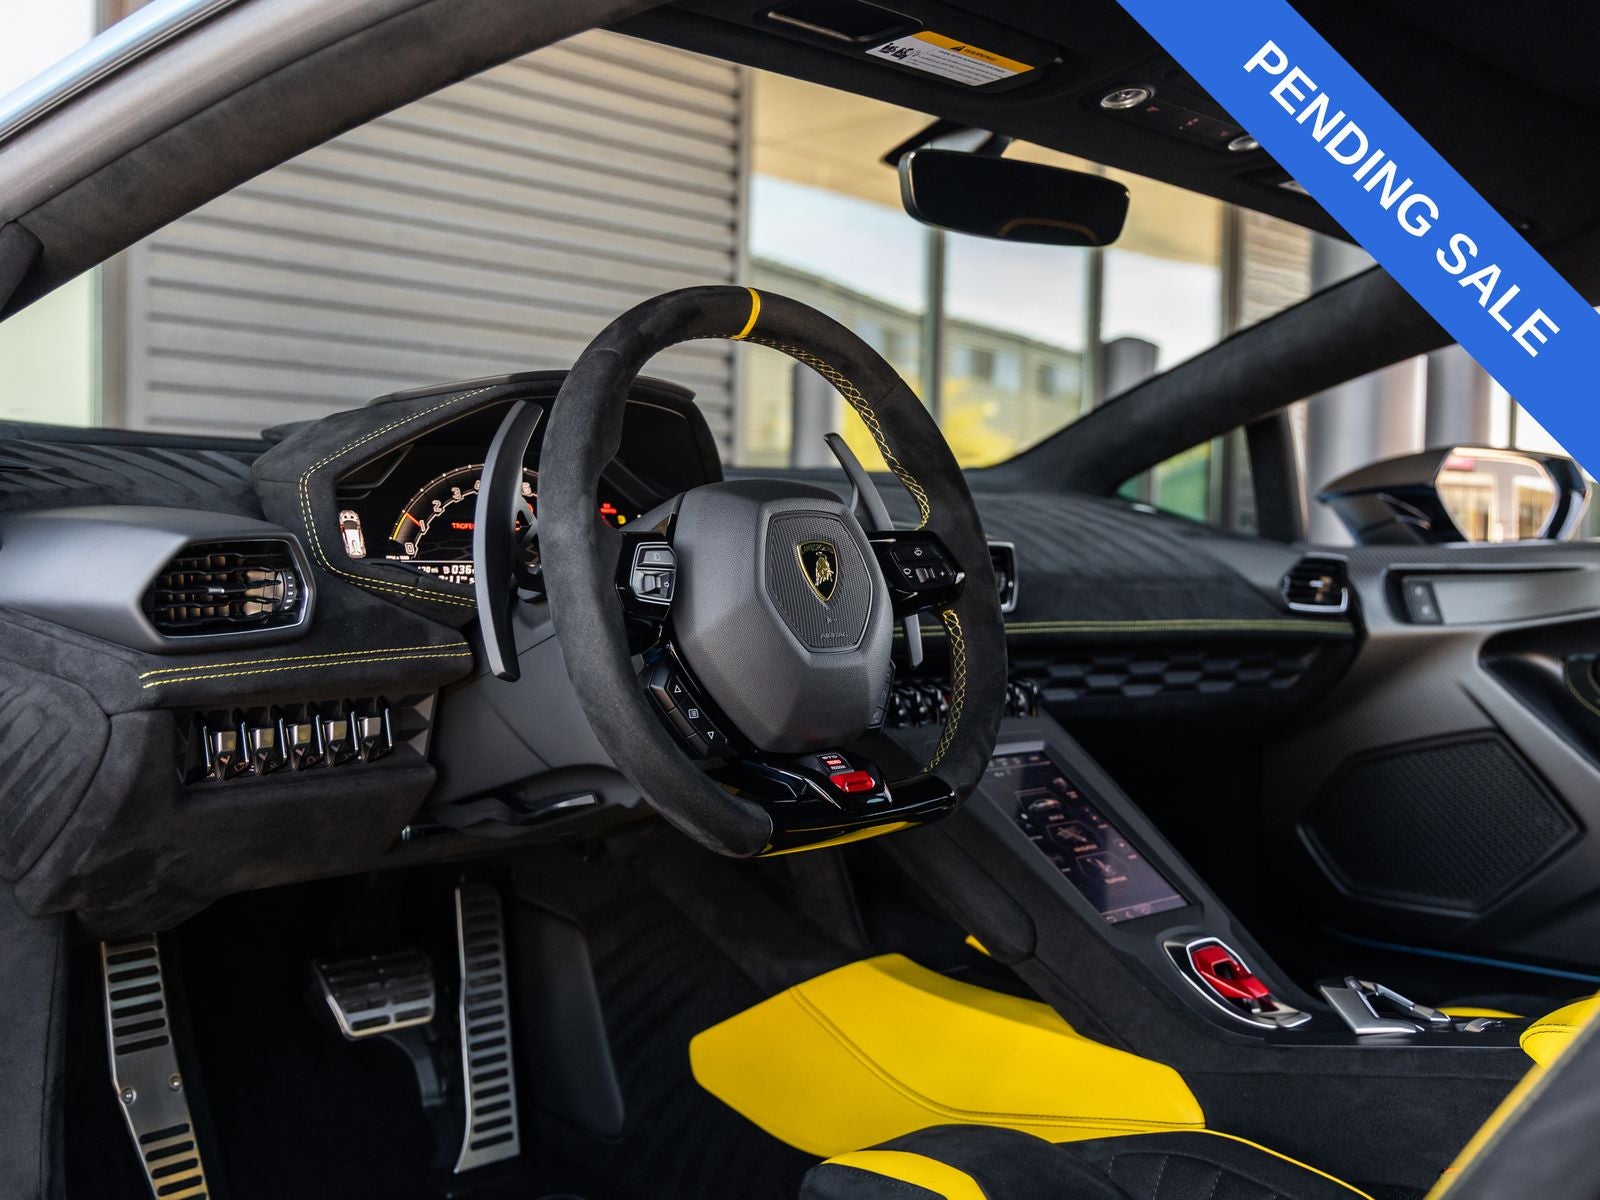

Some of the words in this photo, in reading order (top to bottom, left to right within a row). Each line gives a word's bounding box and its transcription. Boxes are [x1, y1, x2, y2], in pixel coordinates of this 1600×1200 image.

[451, 487, 462, 500] 3
[432, 499, 443, 513] 2
[451, 522, 475, 530] TROFE
[404, 542, 415, 555] 0
